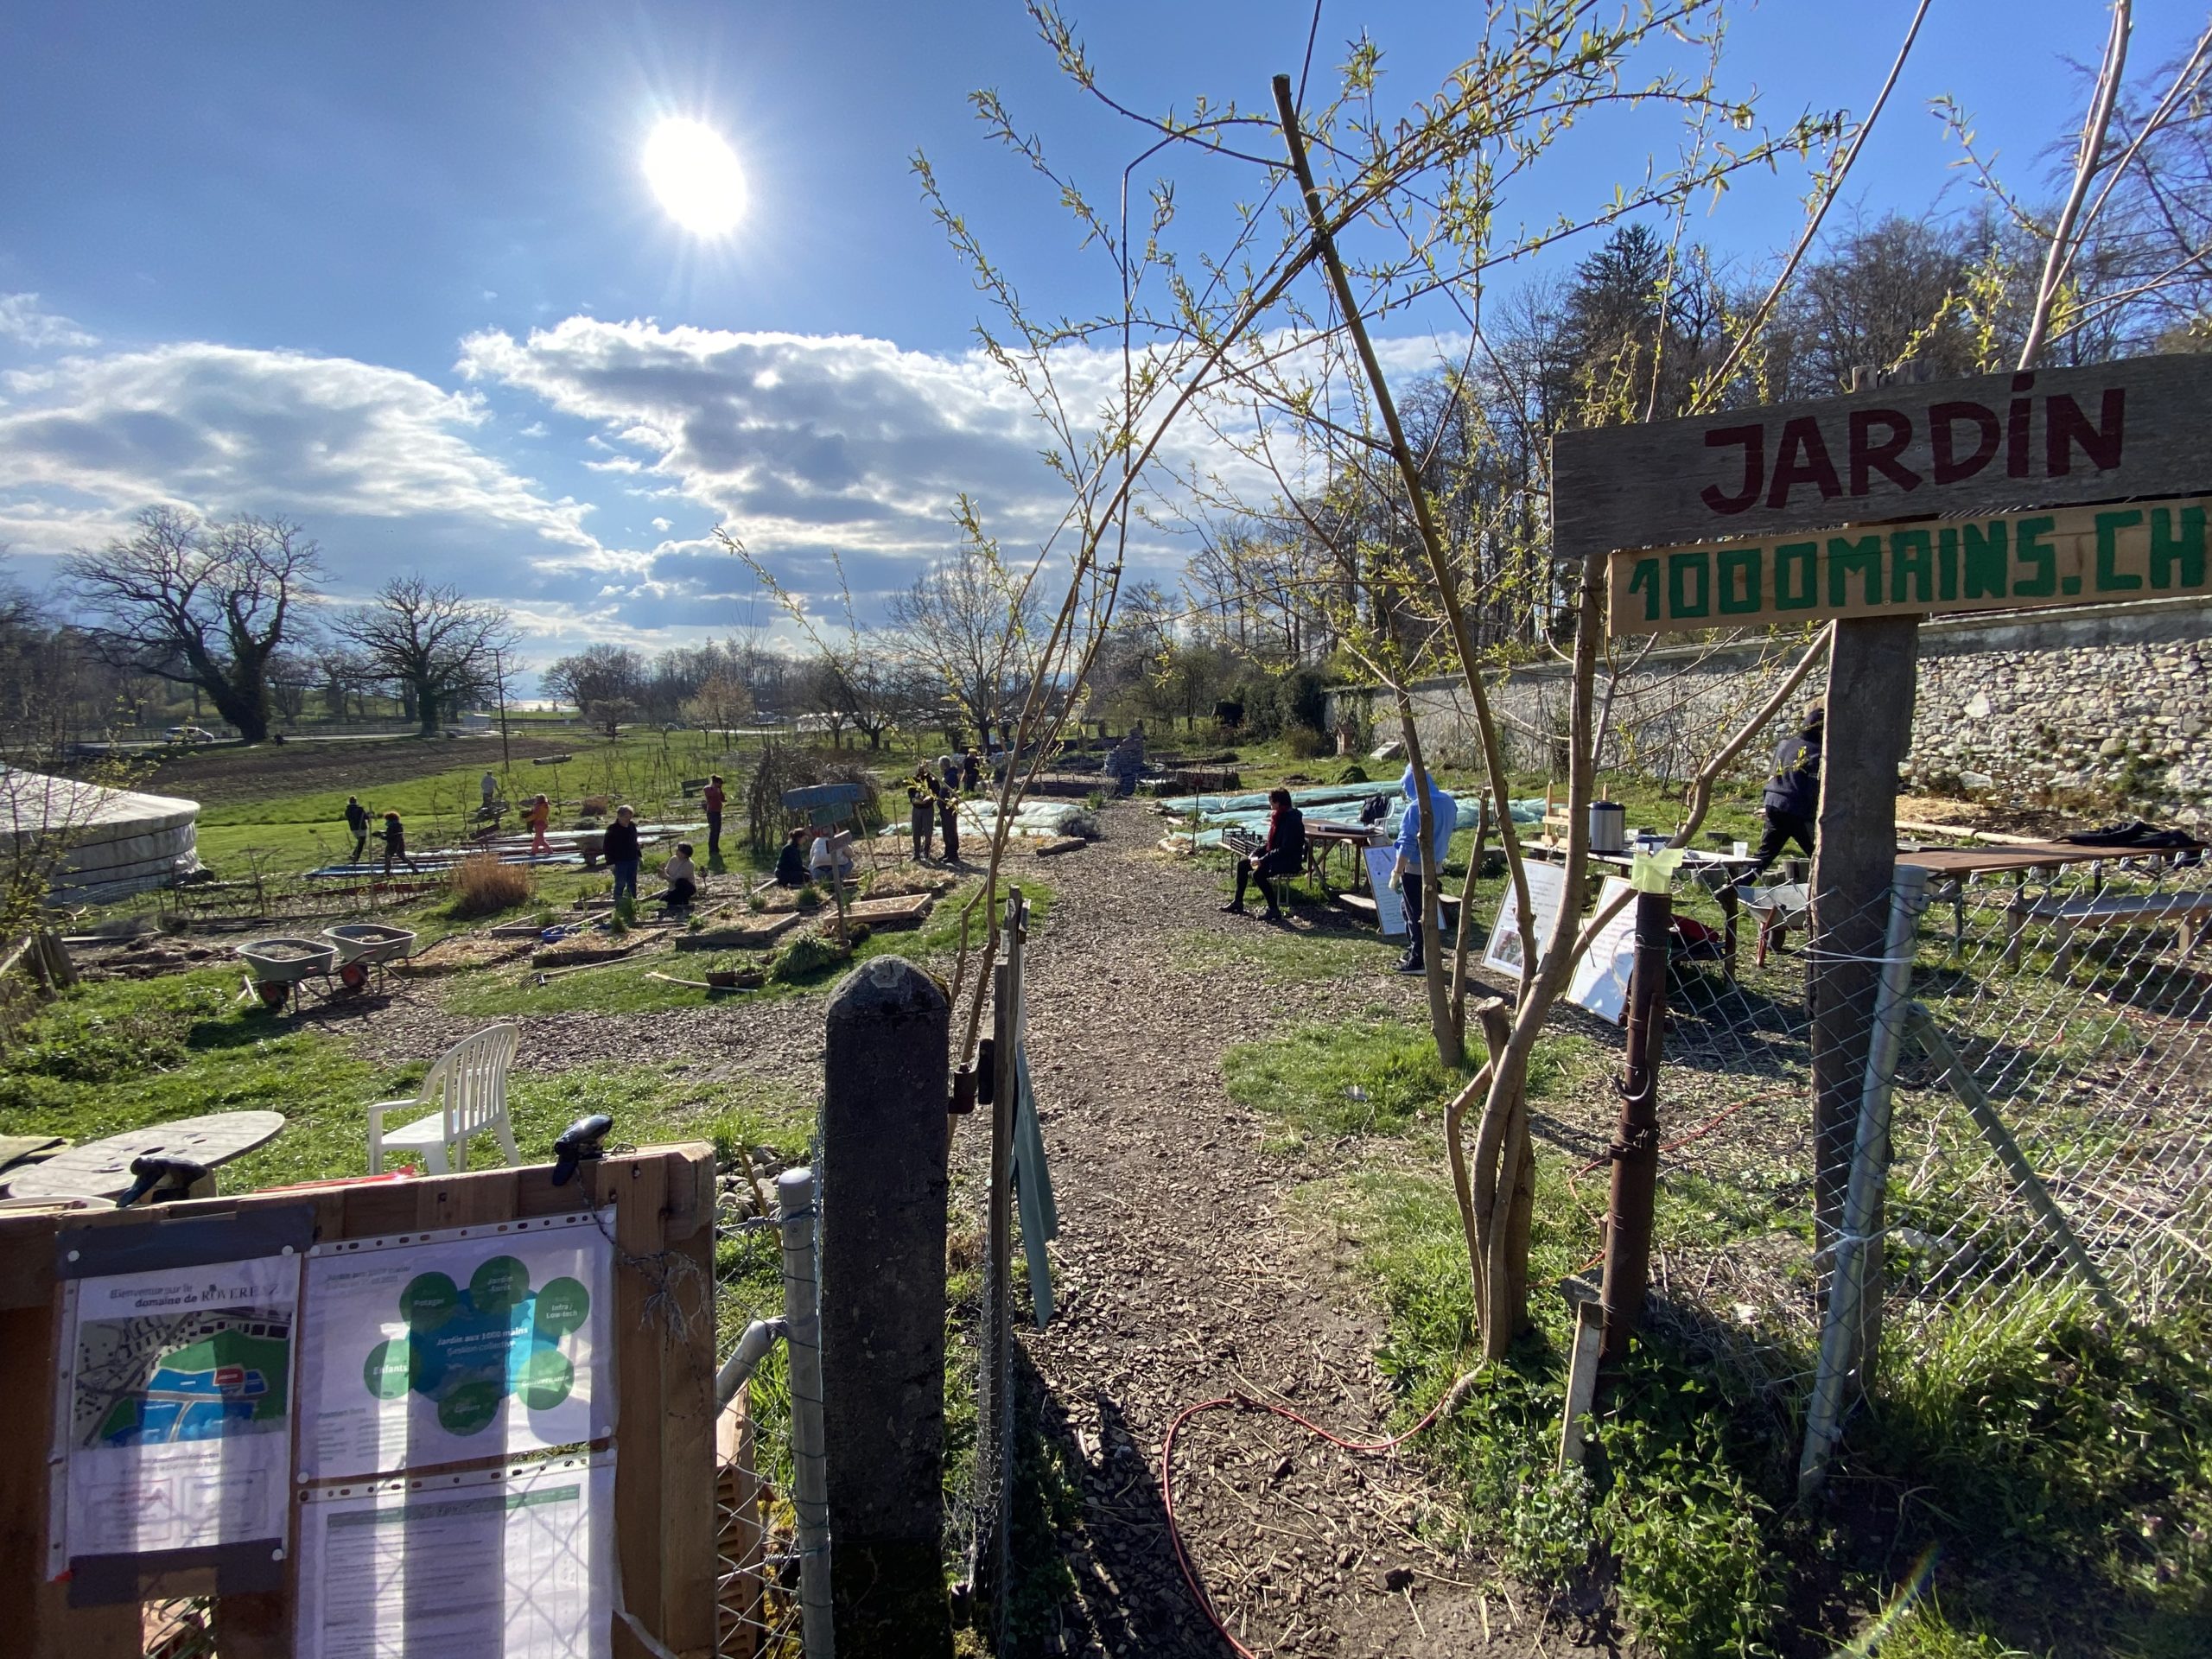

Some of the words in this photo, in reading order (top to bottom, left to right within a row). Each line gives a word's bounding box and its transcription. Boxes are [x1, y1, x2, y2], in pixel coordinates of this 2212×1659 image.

[1629, 506, 2209, 622] 1000MAINS.CH
[111, 1287, 163, 1299] Bienvenue
[164, 1285, 181, 1294] sur
[182, 1283, 193, 1293] le
[135, 1297, 181, 1307] domaine
[183, 1294, 198, 1304] de
[436, 1334, 463, 1346] Jardin
[464, 1333, 480, 1343] aux
[502, 1326, 529, 1337] mains
[478, 1341, 517, 1352] collective
[373, 1364, 409, 1375] Enfants
